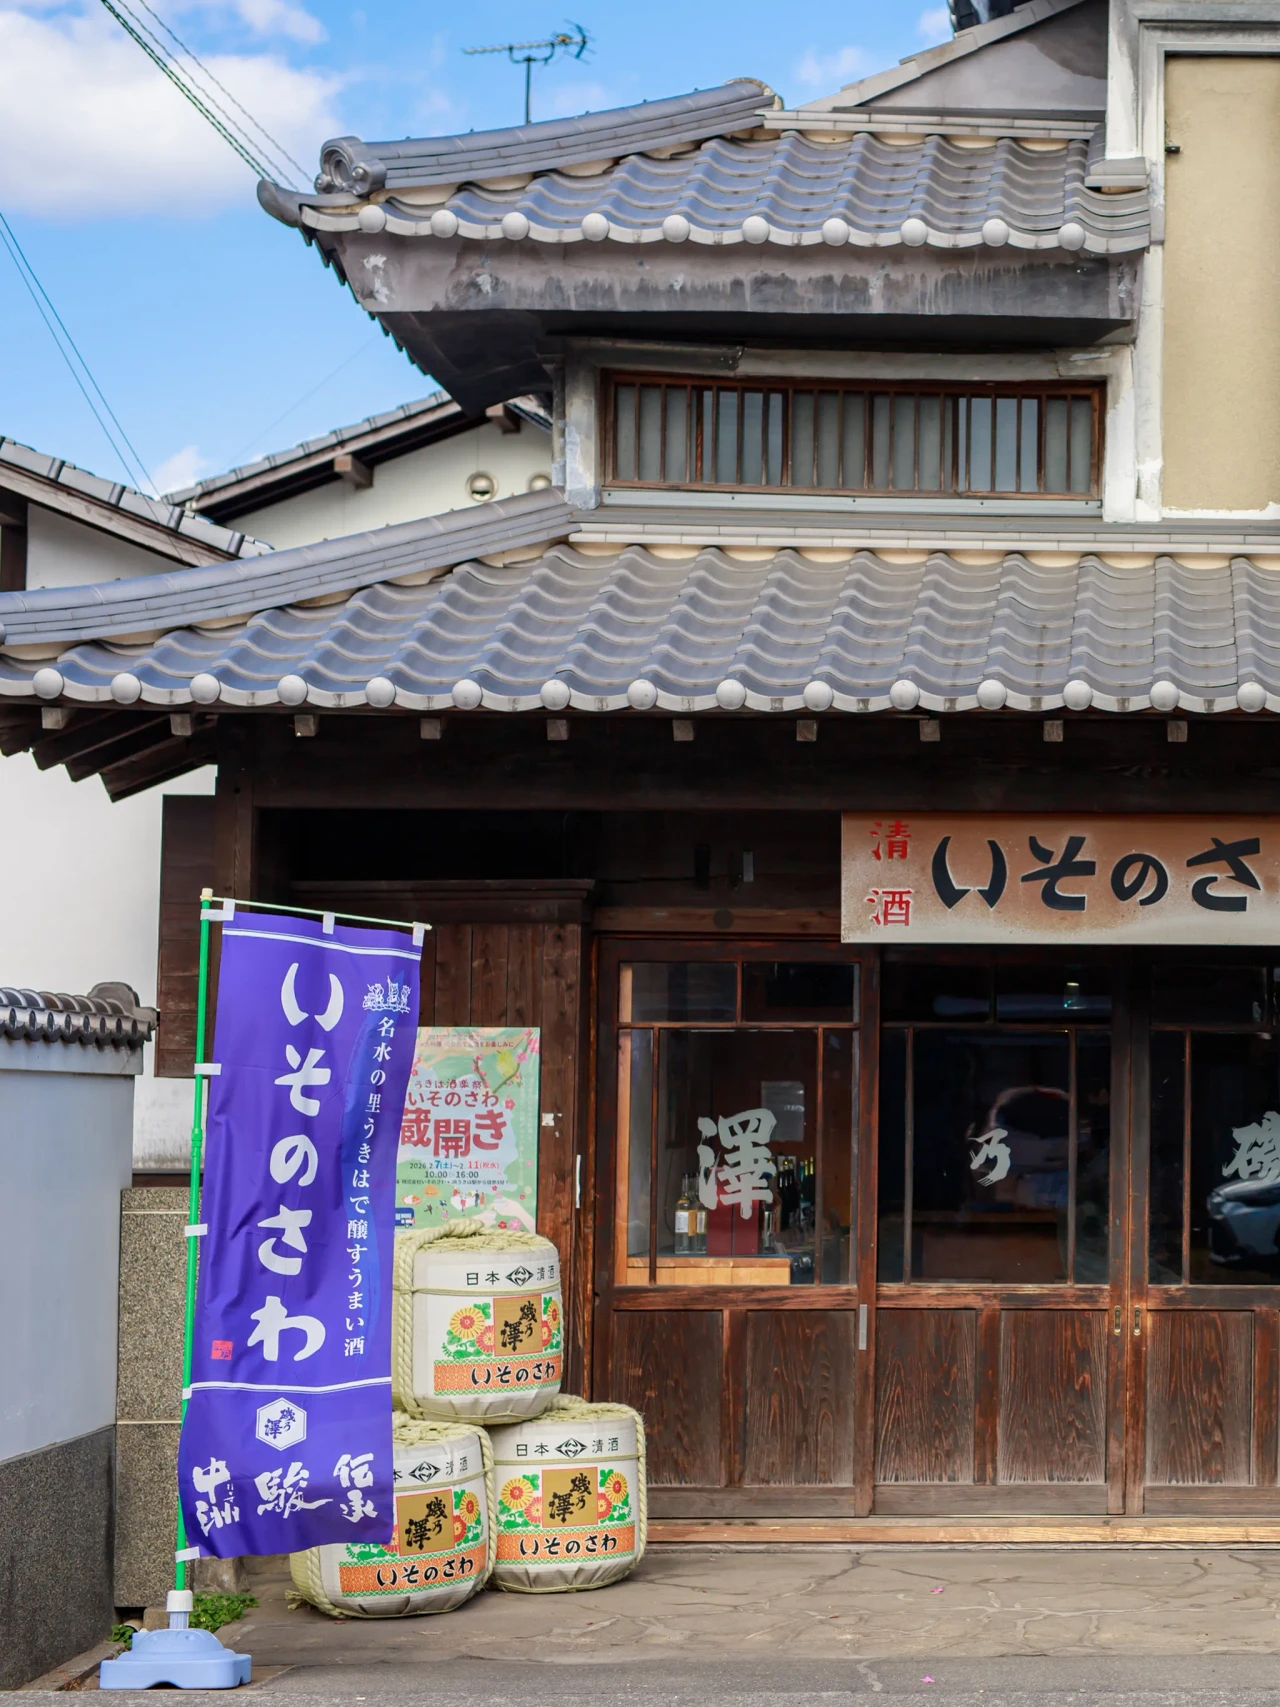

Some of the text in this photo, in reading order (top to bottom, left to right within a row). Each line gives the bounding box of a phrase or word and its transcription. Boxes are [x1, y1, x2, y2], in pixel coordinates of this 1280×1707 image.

[864, 820, 912, 927] 清酒
[408, 1091, 499, 1107] いそのさわ
[401, 1107, 507, 1158] 蔵開き
[248, 962, 344, 1362] いそのさわ
[697, 1108, 777, 1219] 澤
[344, 1016, 395, 1356] 名水の里うきはで醸すうまい酒
[466, 1271, 500, 1286] 日本
[471, 1362, 556, 1386] いそのさわ
[516, 1437, 618, 1456] 日本 清酒
[333, 1453, 378, 1523] 伝承
[520, 1534, 617, 1556] いそのさわ
[376, 1557, 474, 1587] いそのさわ
